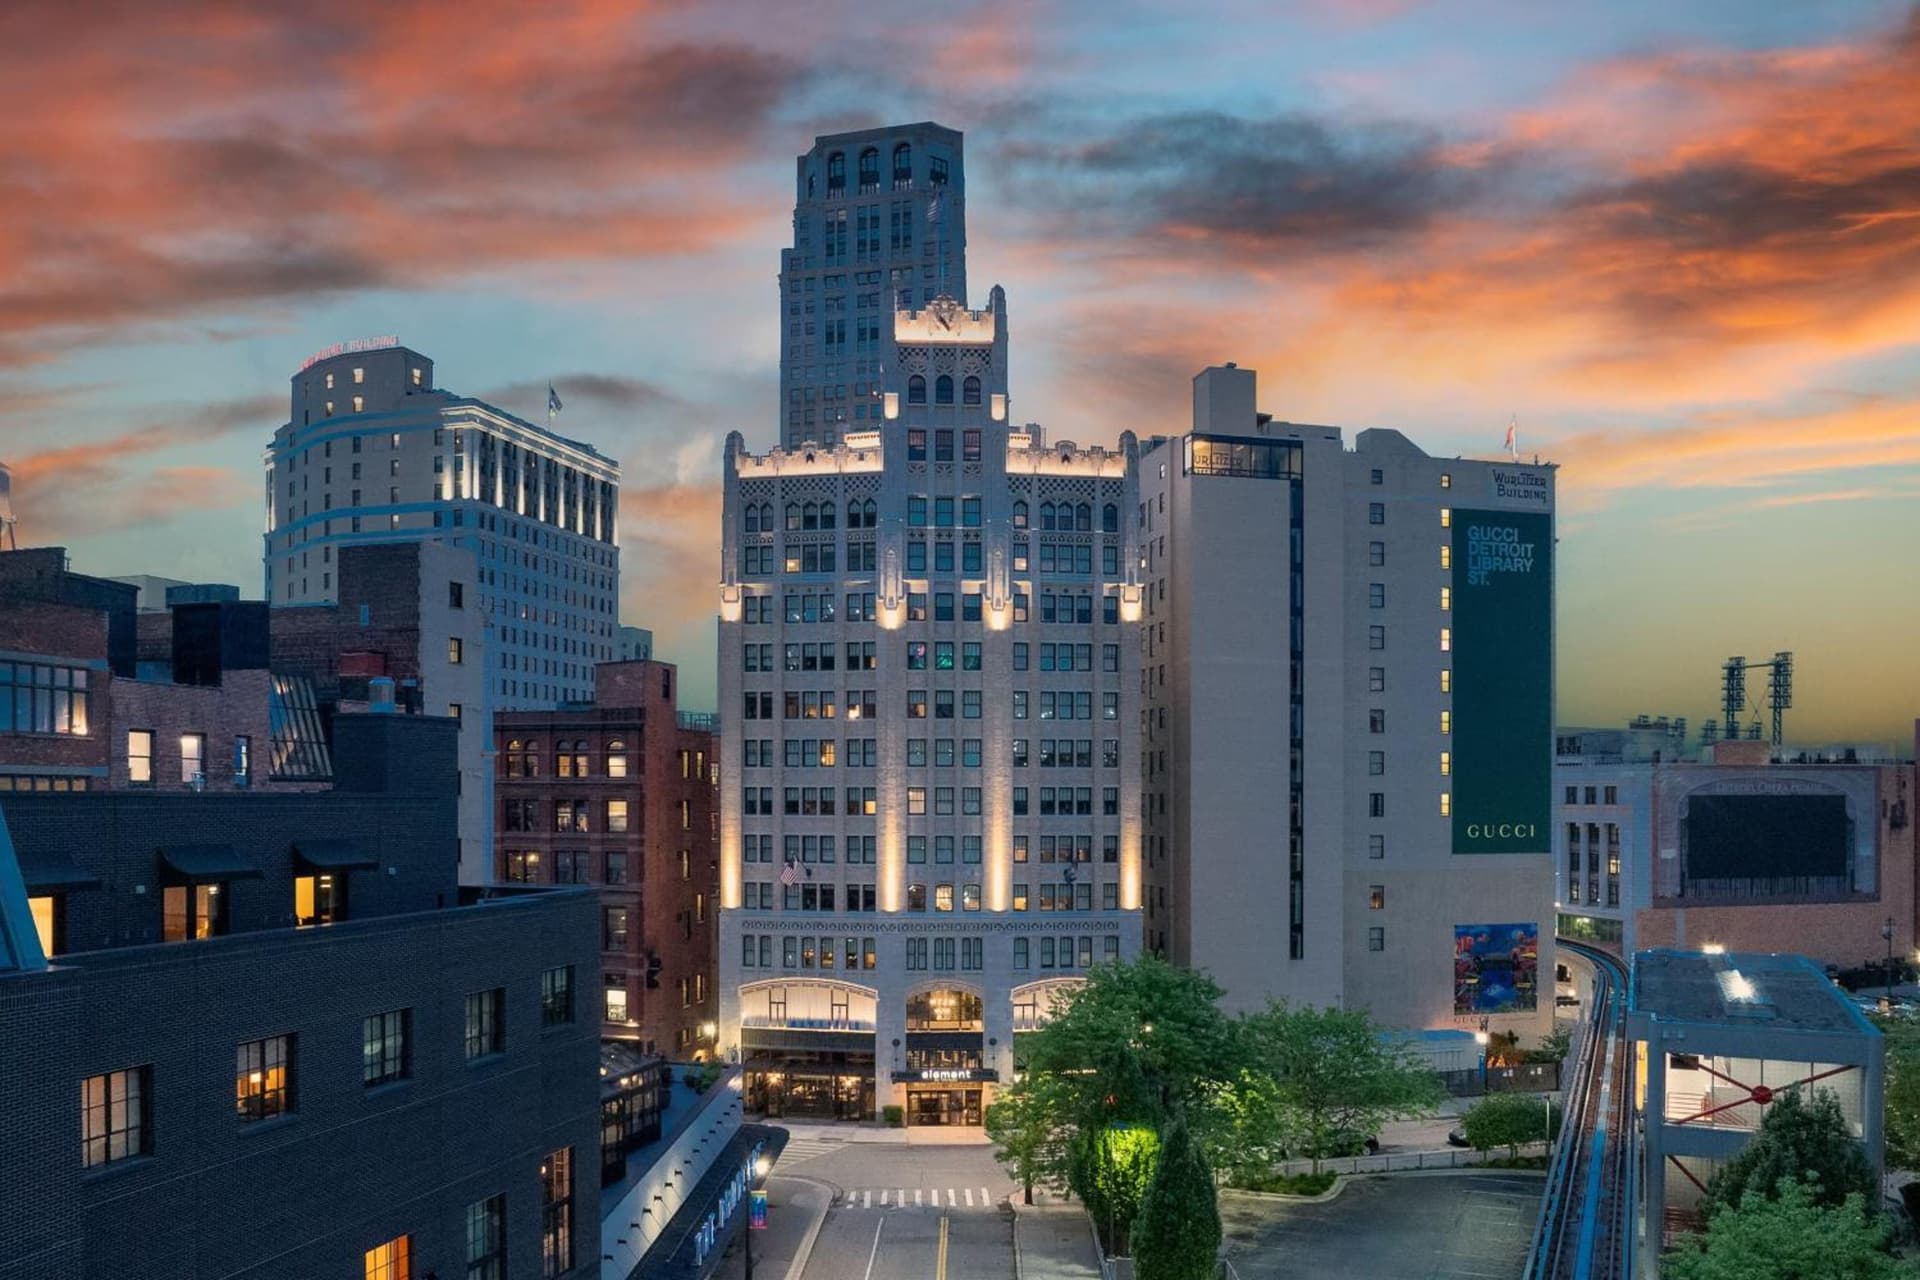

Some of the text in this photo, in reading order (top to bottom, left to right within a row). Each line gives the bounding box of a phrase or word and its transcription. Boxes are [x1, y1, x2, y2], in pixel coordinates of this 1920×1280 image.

[1467, 526, 1519, 542] GUCCI
[1468, 541, 1534, 557] DETROIT
[1468, 556, 1534, 573] LIBRARY
[1467, 570, 1490, 585] ST.
[1467, 824, 1534, 838] GUCCI
[921, 1069, 971, 1079] element
